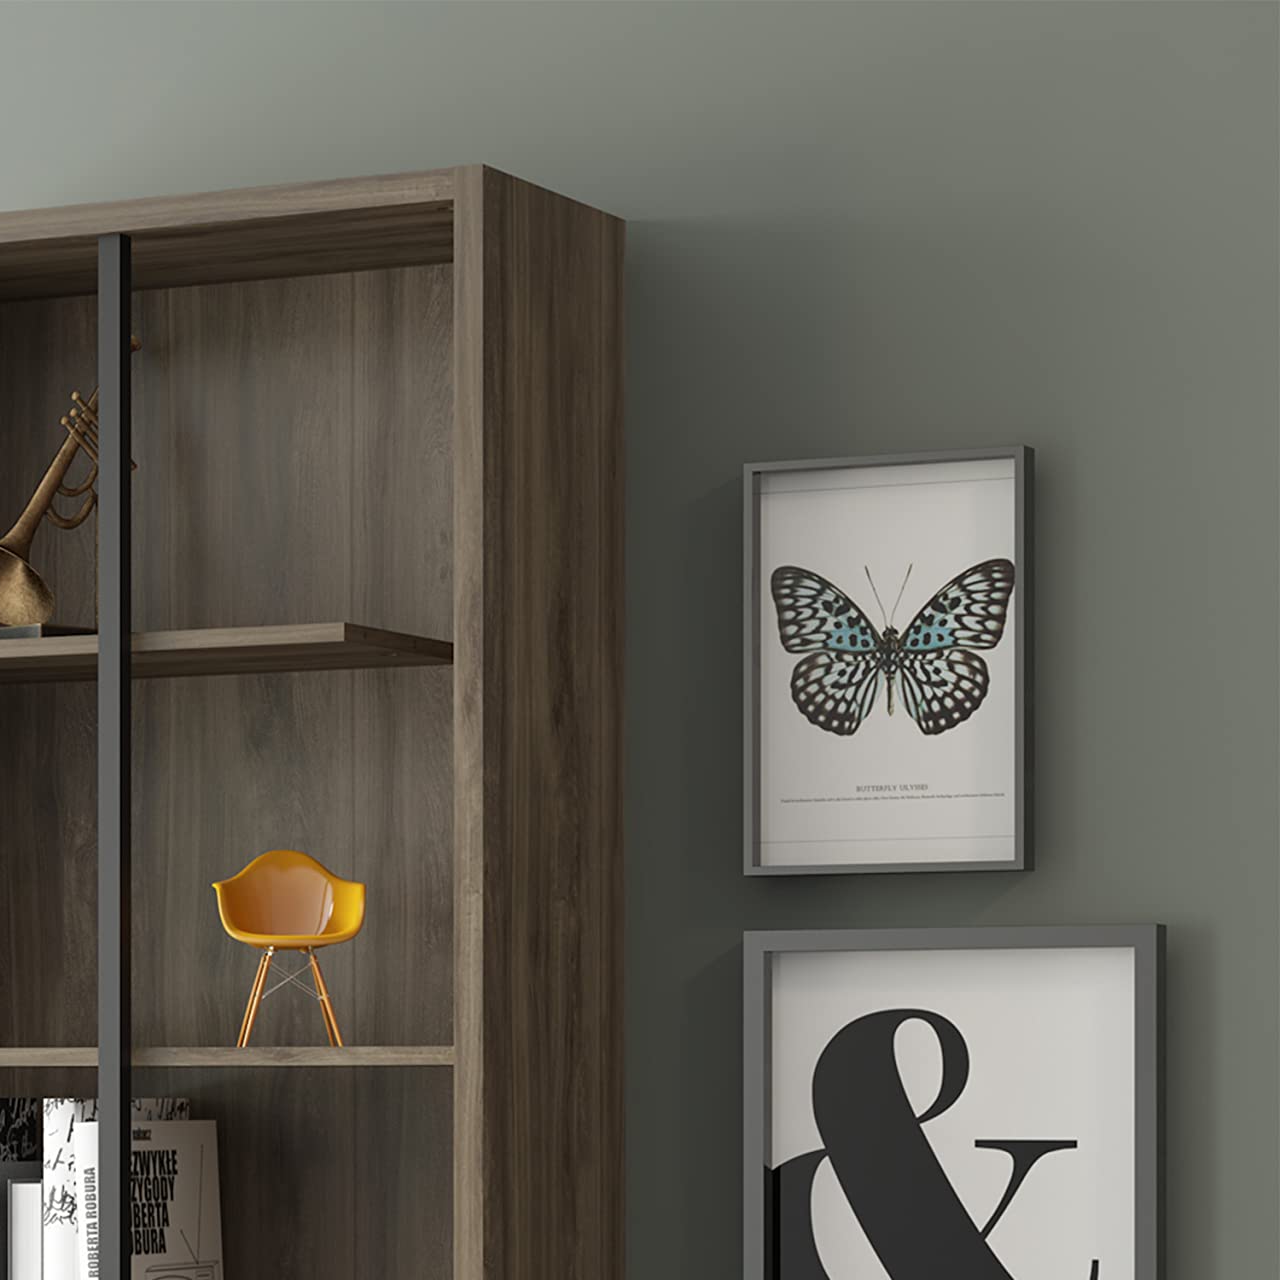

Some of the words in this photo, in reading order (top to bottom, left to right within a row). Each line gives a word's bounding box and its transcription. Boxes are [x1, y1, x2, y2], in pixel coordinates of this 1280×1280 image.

[131, 1149, 178, 1176] ZWYKŁE
[84, 1167, 98, 1219] ROBURA
[131, 1176, 175, 1202] ZYGODY
[131, 1202, 170, 1229] BERTA
[86, 1222, 99, 1278] ROBERTA
[132, 1227, 167, 1256] BURA
